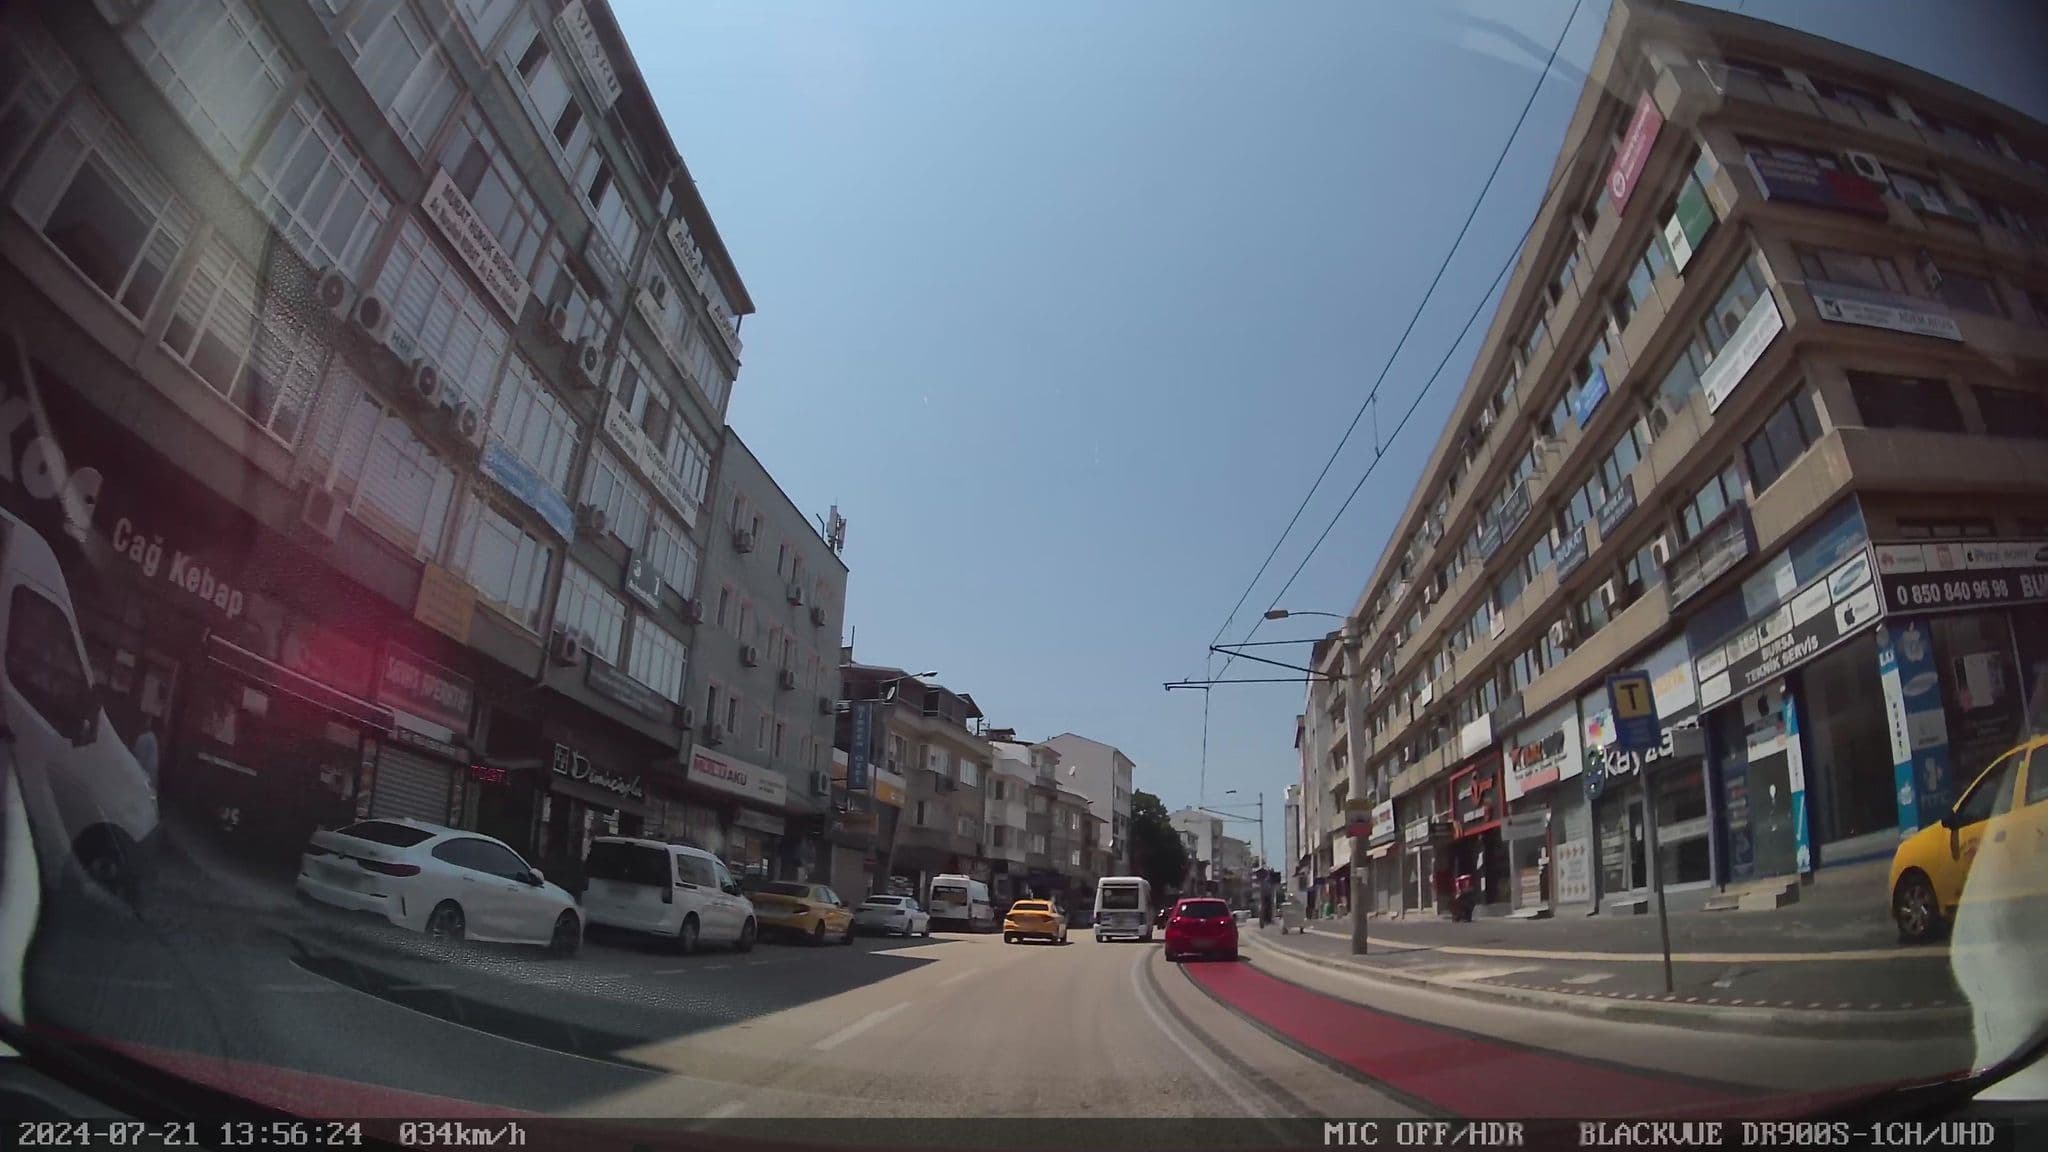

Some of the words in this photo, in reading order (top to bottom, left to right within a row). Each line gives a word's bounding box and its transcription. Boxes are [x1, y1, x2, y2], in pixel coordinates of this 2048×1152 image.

[113, 517, 164, 577] Cağ
[169, 551, 244, 619] Kebap
[1896, 585, 1908, 605] 0
[1911, 583, 1941, 605] 850
[1944, 581, 1970, 602] 840
[1973, 580, 1990, 599] 96
[1991, 579, 2008, 598] 98
[2019, 573, 2048, 598] BU
[1745, 656, 1781, 684] TEKNİK
[1782, 634, 1819, 667] SERVİS
[1761, 633, 1795, 661] BURSA
[1620, 684, 1640, 711] T
